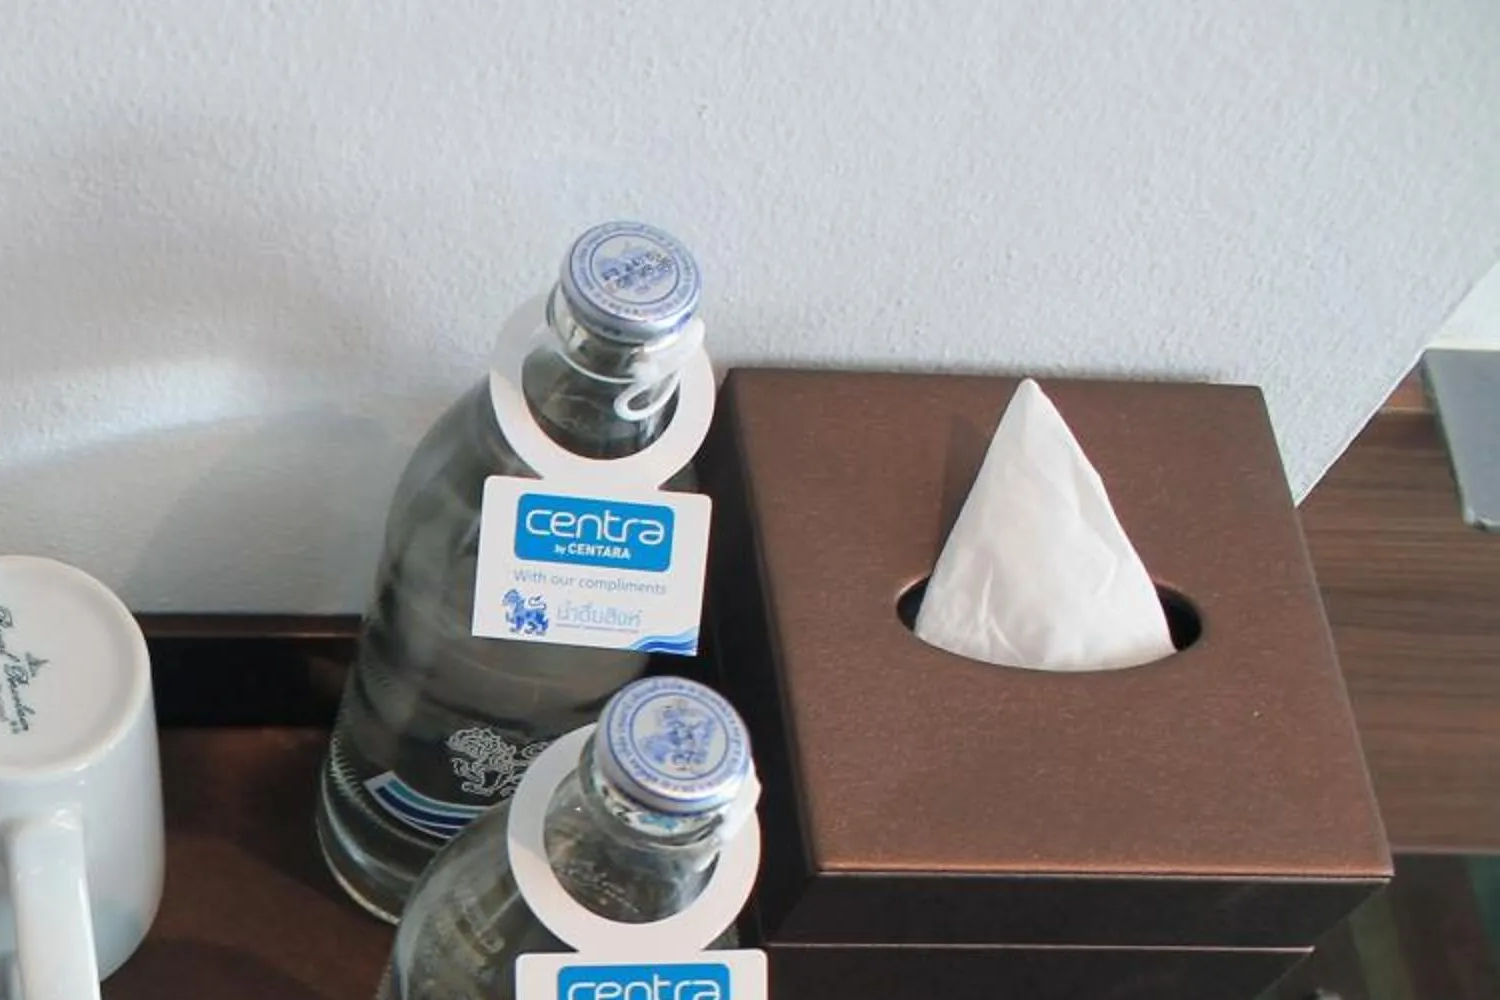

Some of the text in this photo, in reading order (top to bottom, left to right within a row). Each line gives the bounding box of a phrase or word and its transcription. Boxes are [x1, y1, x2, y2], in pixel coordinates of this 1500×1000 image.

[526, 509, 665, 545] centra
[567, 543, 632, 559] CENTARA
[513, 569, 668, 595] With our compliments
